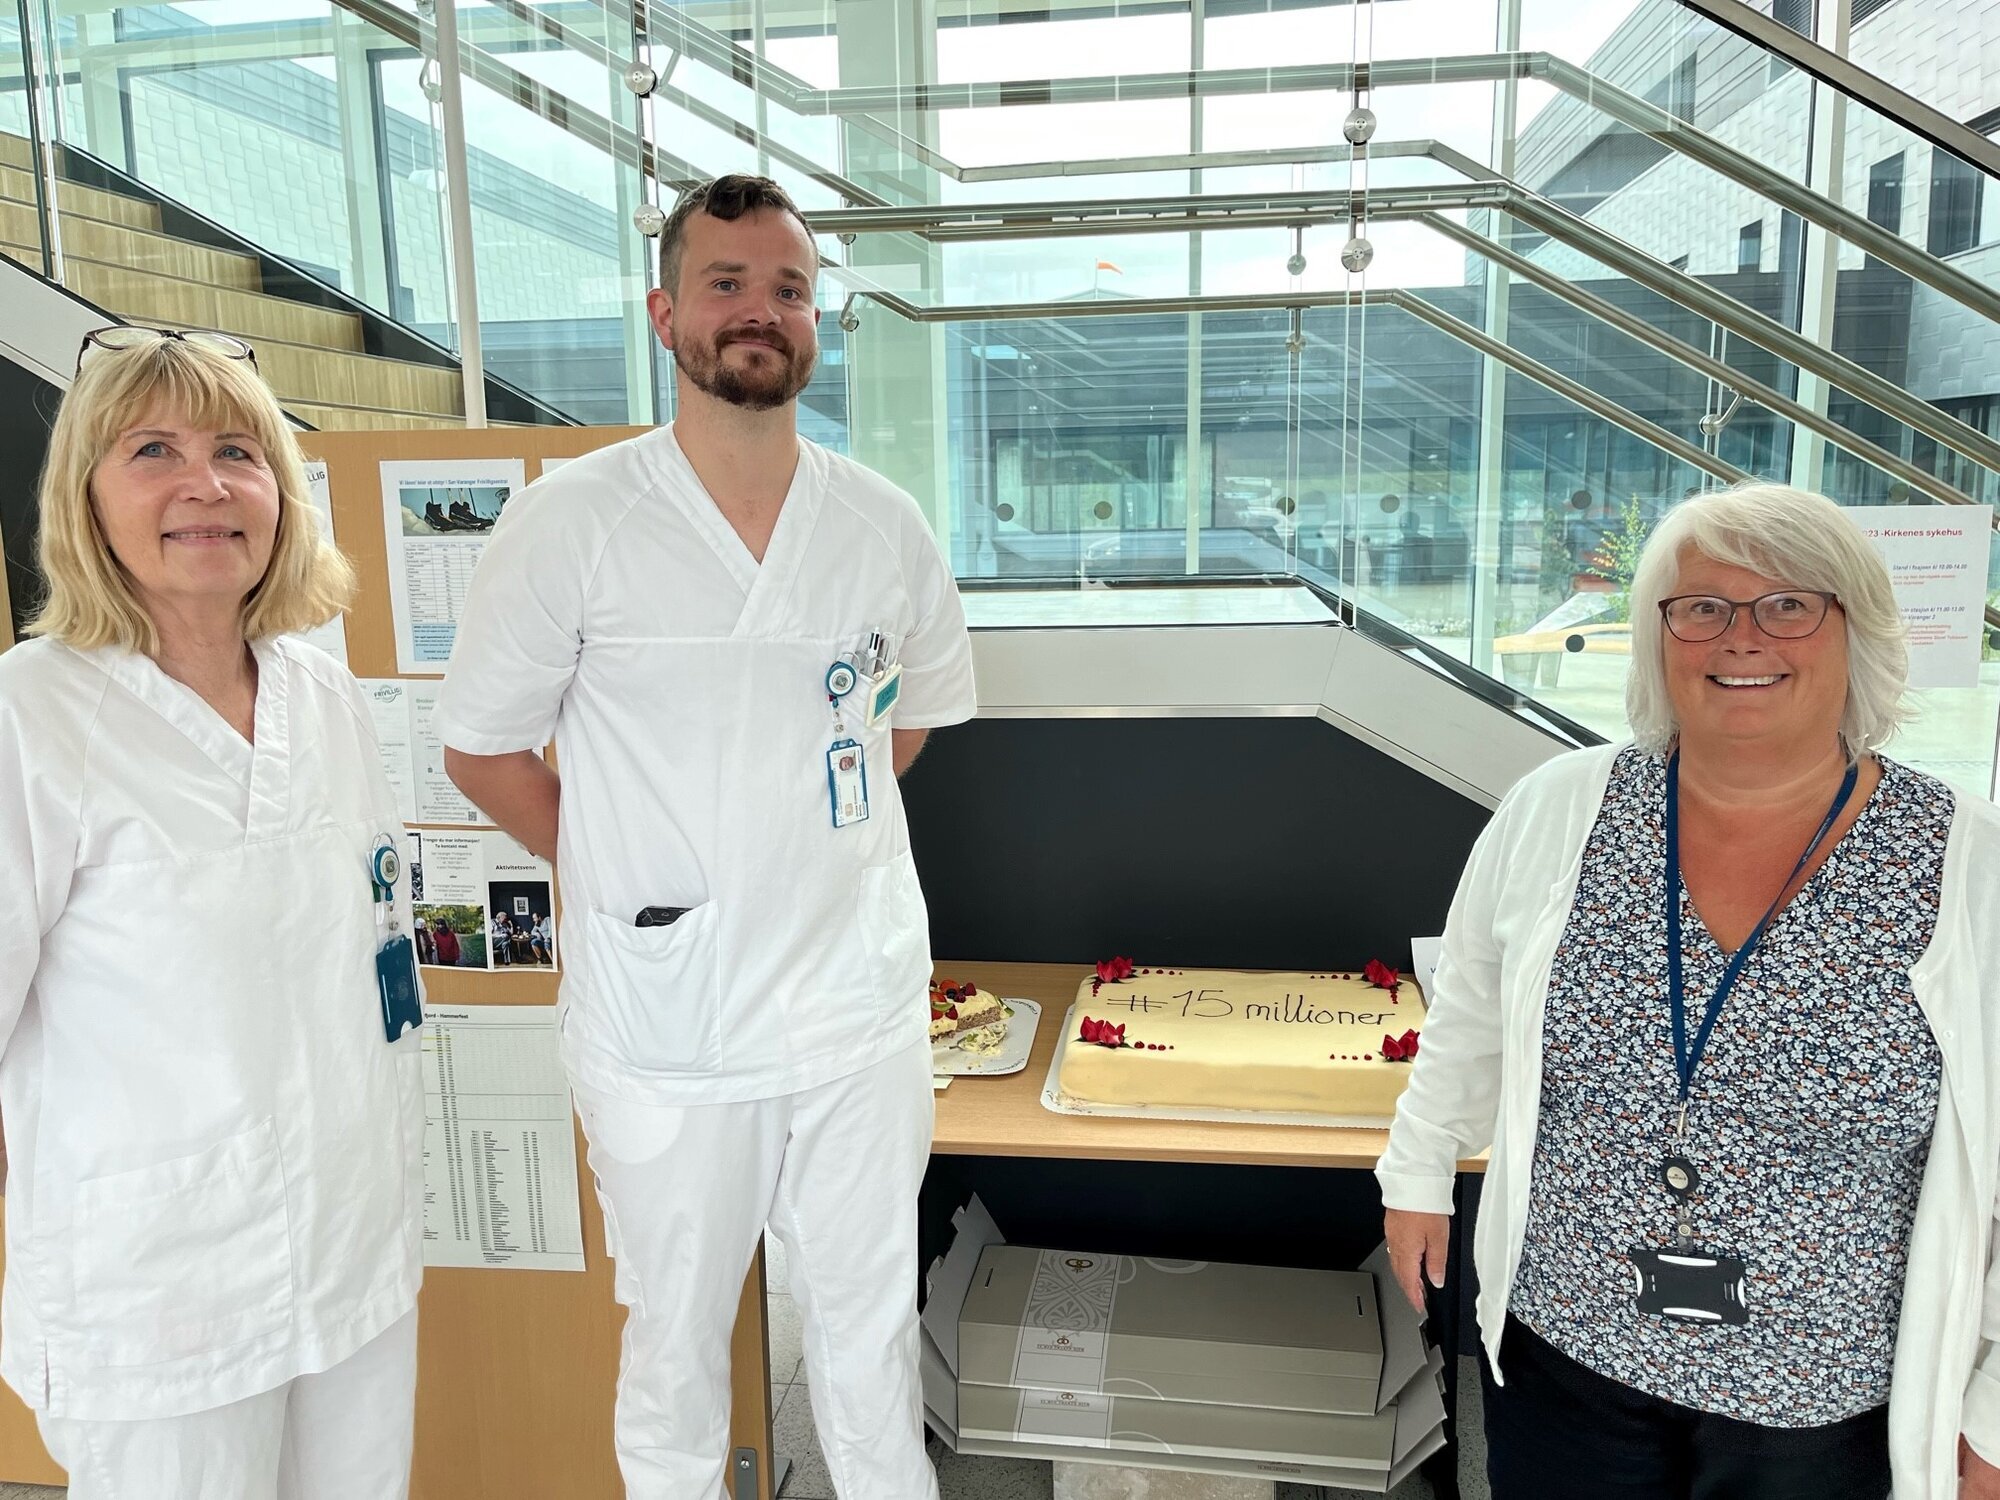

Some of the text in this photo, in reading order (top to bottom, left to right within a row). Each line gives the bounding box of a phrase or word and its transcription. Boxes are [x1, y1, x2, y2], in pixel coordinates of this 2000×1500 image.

[306, 471, 326, 482] LLIG
[1926, 528, 1963, 538] sykehus
[1245, 992, 1396, 1026] millioner
